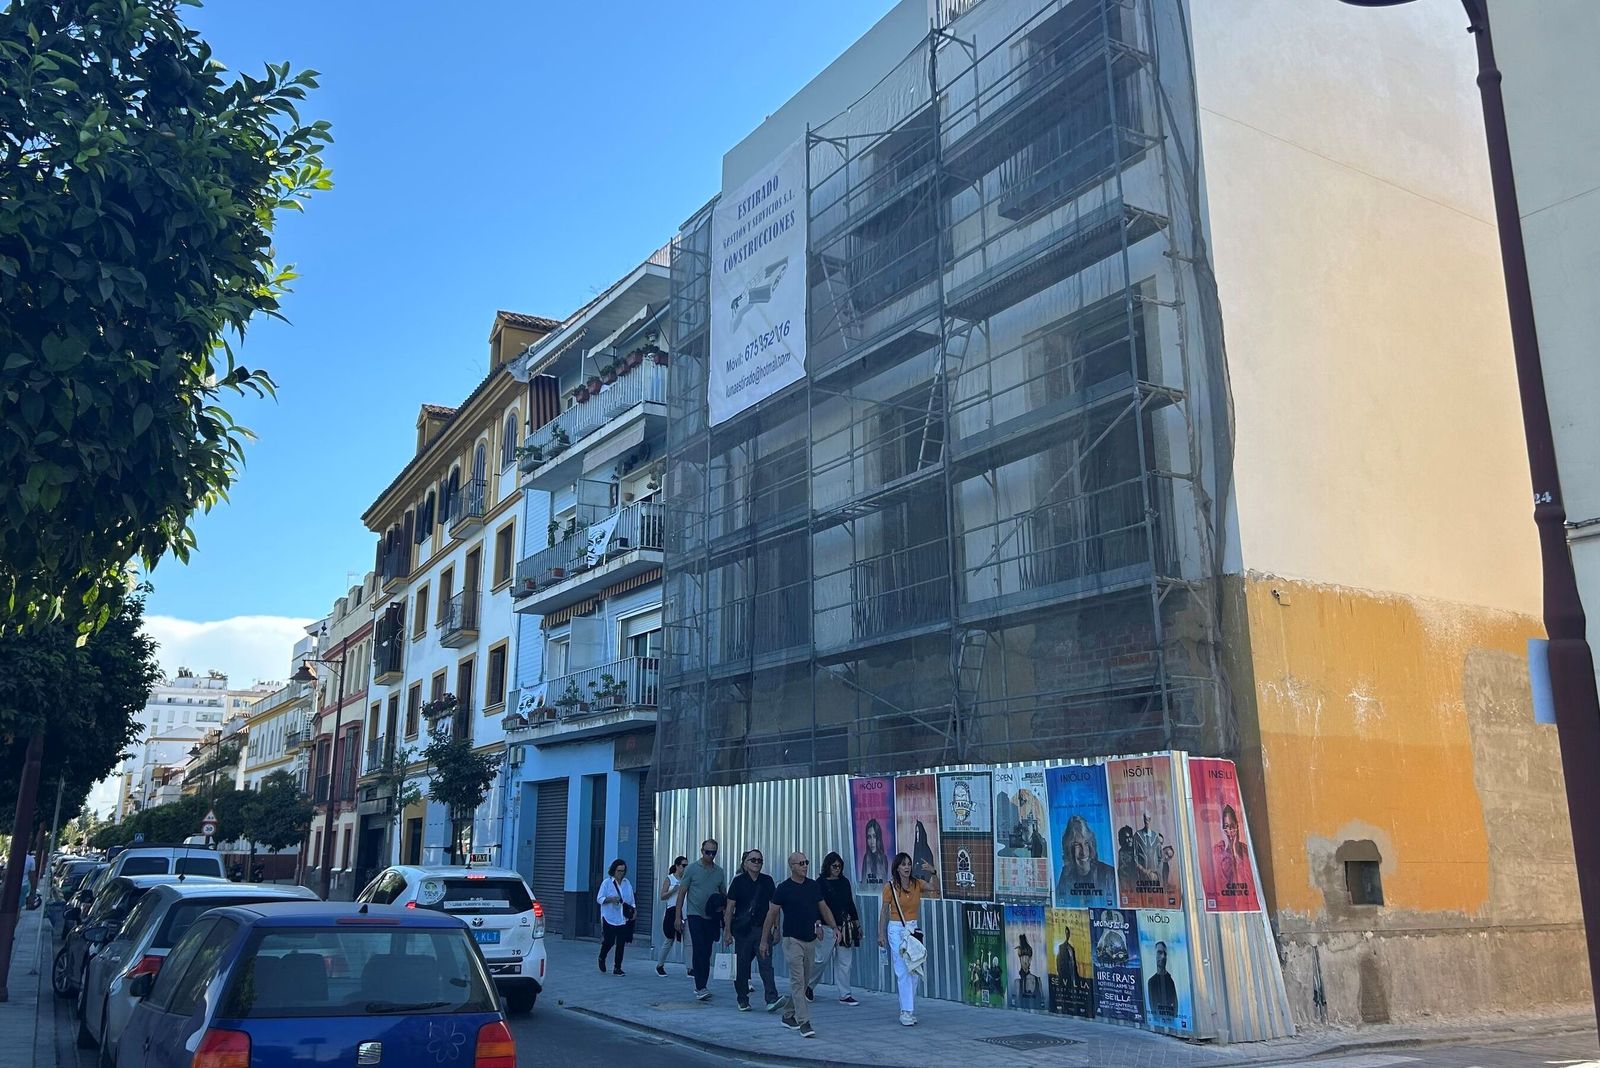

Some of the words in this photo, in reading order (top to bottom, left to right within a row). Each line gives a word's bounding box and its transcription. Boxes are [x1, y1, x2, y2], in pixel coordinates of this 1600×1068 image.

[738, 175, 779, 220] ESTIRADO
[752, 196, 782, 228] SERVICIOS
[724, 209, 795, 274] CONSTRUCCIONES
